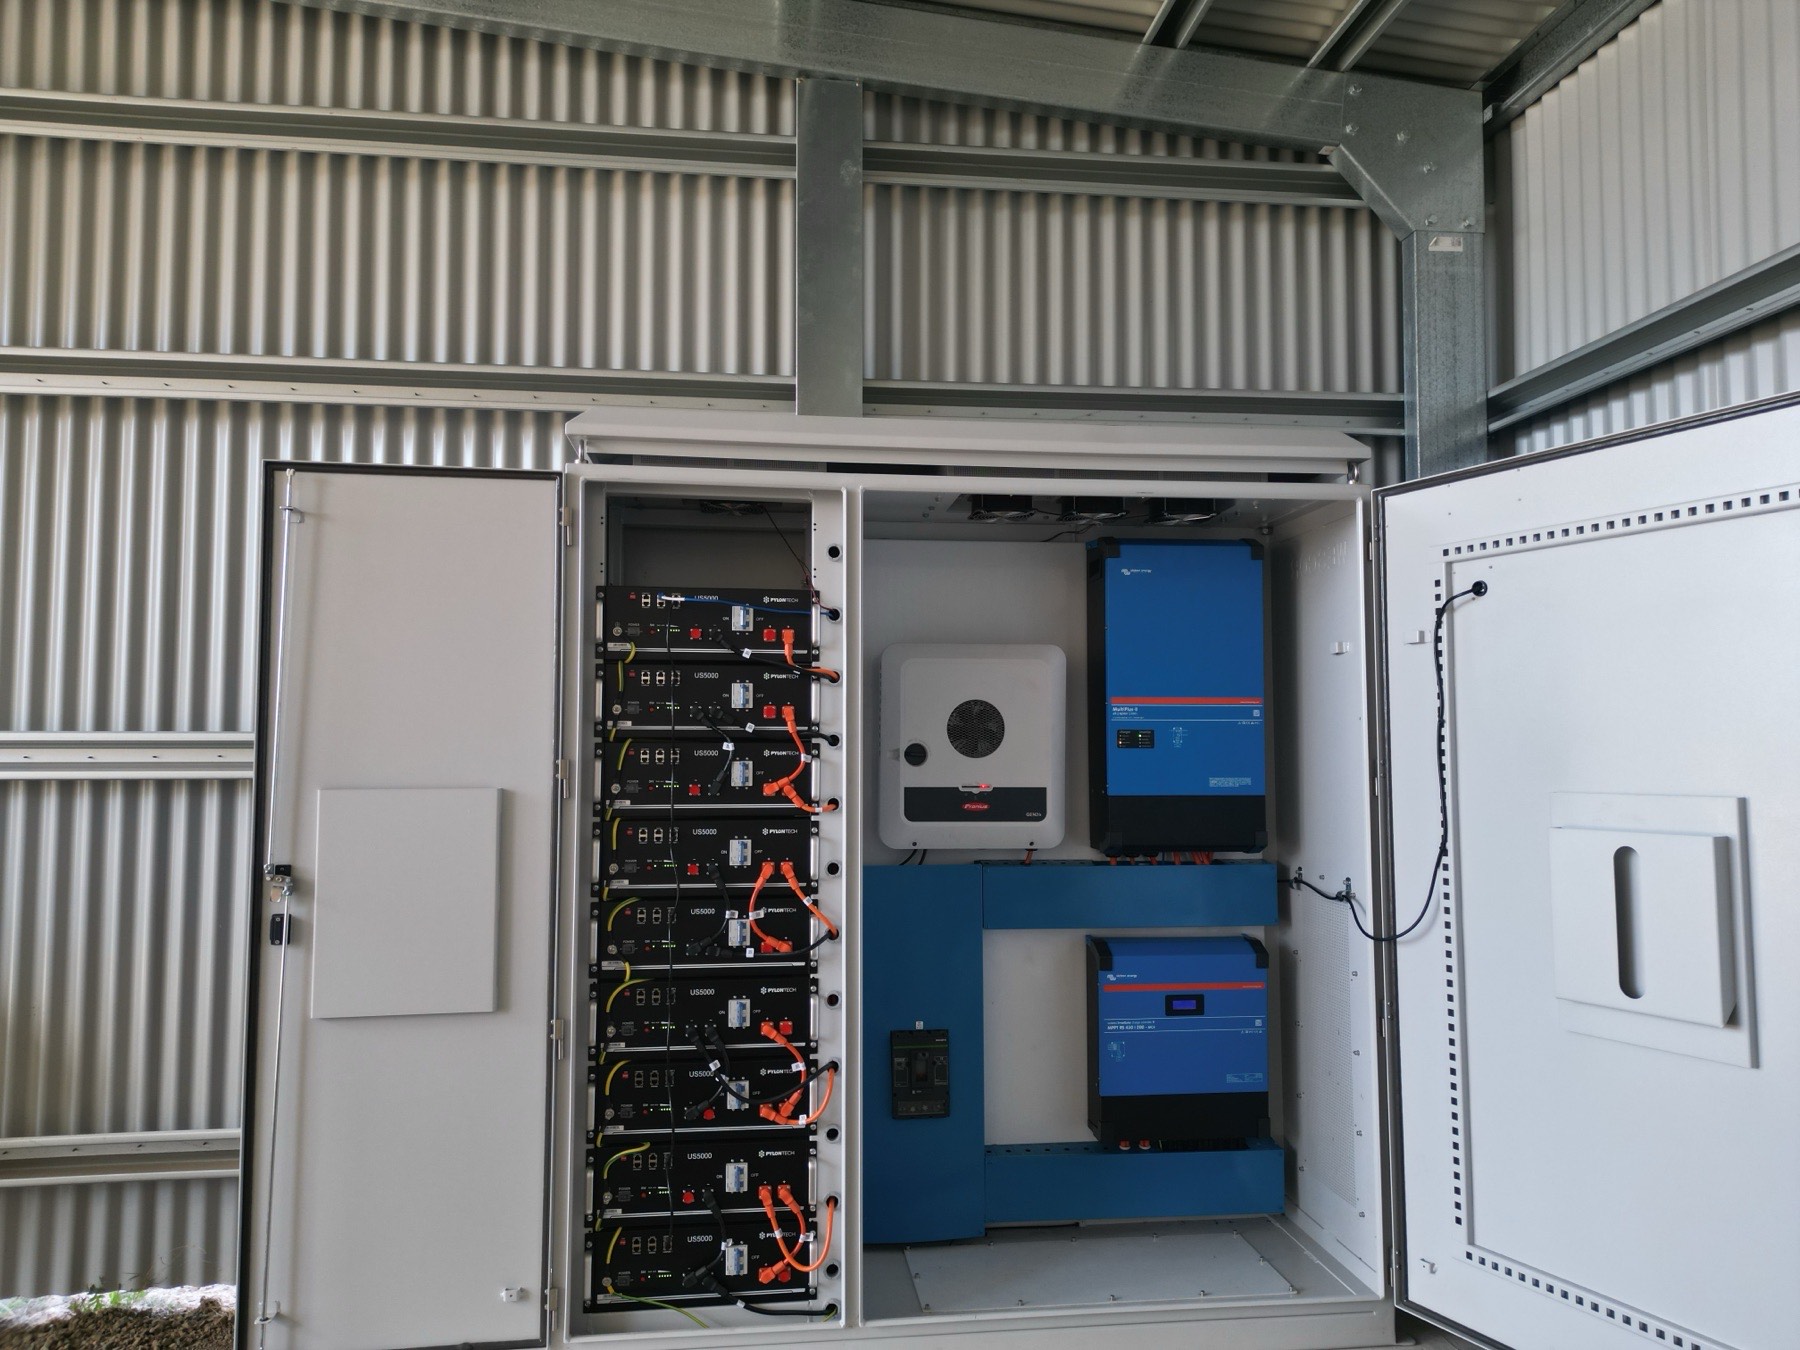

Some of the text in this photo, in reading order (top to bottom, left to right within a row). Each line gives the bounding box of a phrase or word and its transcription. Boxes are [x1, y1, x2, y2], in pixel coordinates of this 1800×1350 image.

[689, 988, 715, 996] US5000
[688, 1070, 714, 1078] US5000
[687, 1152, 713, 1160] US5000
[687, 1235, 713, 1243] US5000
